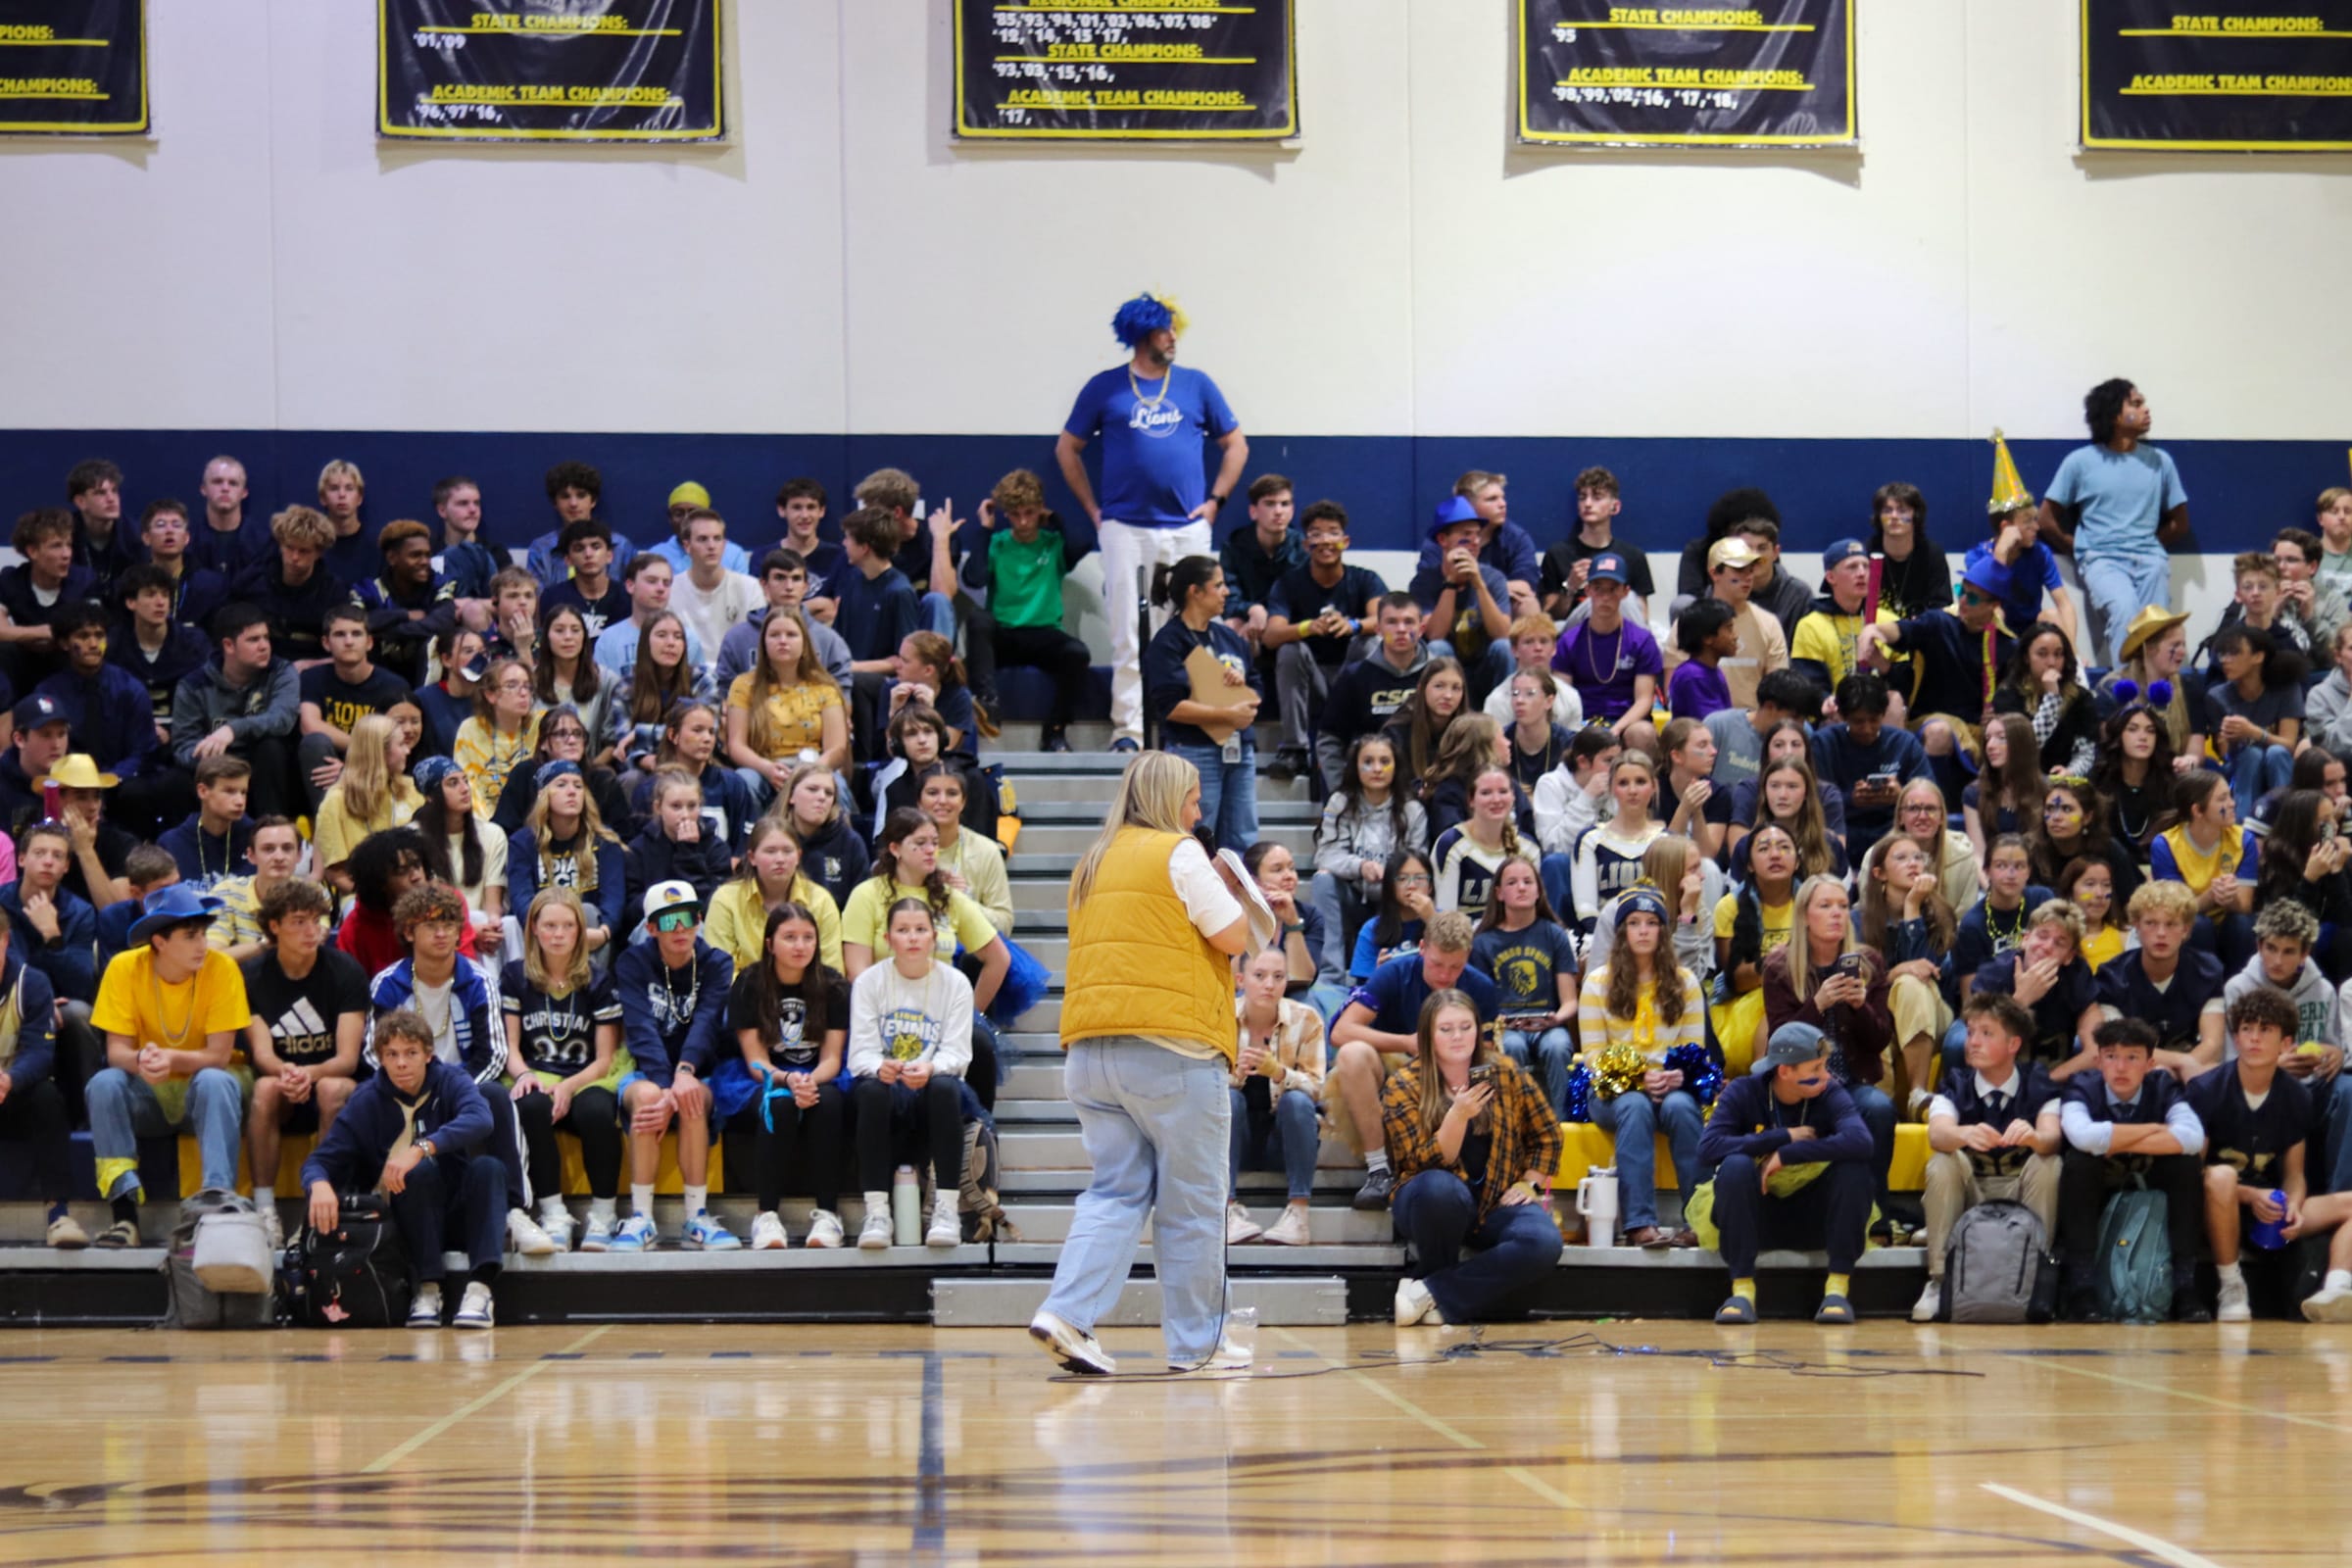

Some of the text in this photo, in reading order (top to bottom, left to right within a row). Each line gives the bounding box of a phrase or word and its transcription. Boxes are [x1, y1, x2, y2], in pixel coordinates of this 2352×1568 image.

[471, 14, 628, 30] STATE CHAMPIONS:
[1609, 8, 1763, 25] STATE CHAMPIONS:
[2172, 16, 2324, 31] STATE CHAMPIONS:
[1551, 28, 1577, 43] '95
[1048, 44, 1203, 59] STATE CHAMPIONS:
[1568, 68, 1803, 85] ACADEMIC TEAM CHAMPIONS:
[2131, 74, 2215, 89] ACADEMIC
[2218, 74, 2261, 89] TEAM
[431, 85, 670, 102] ACADEMIC TEAM CHAMPIONS:
[1007, 89, 1246, 106] ACADEMIC TEAM CHAMPIONS:
[999, 108, 1032, 125] '17,
[1129, 404, 1184, 428] Lions
[324, 697, 377, 726] LION
